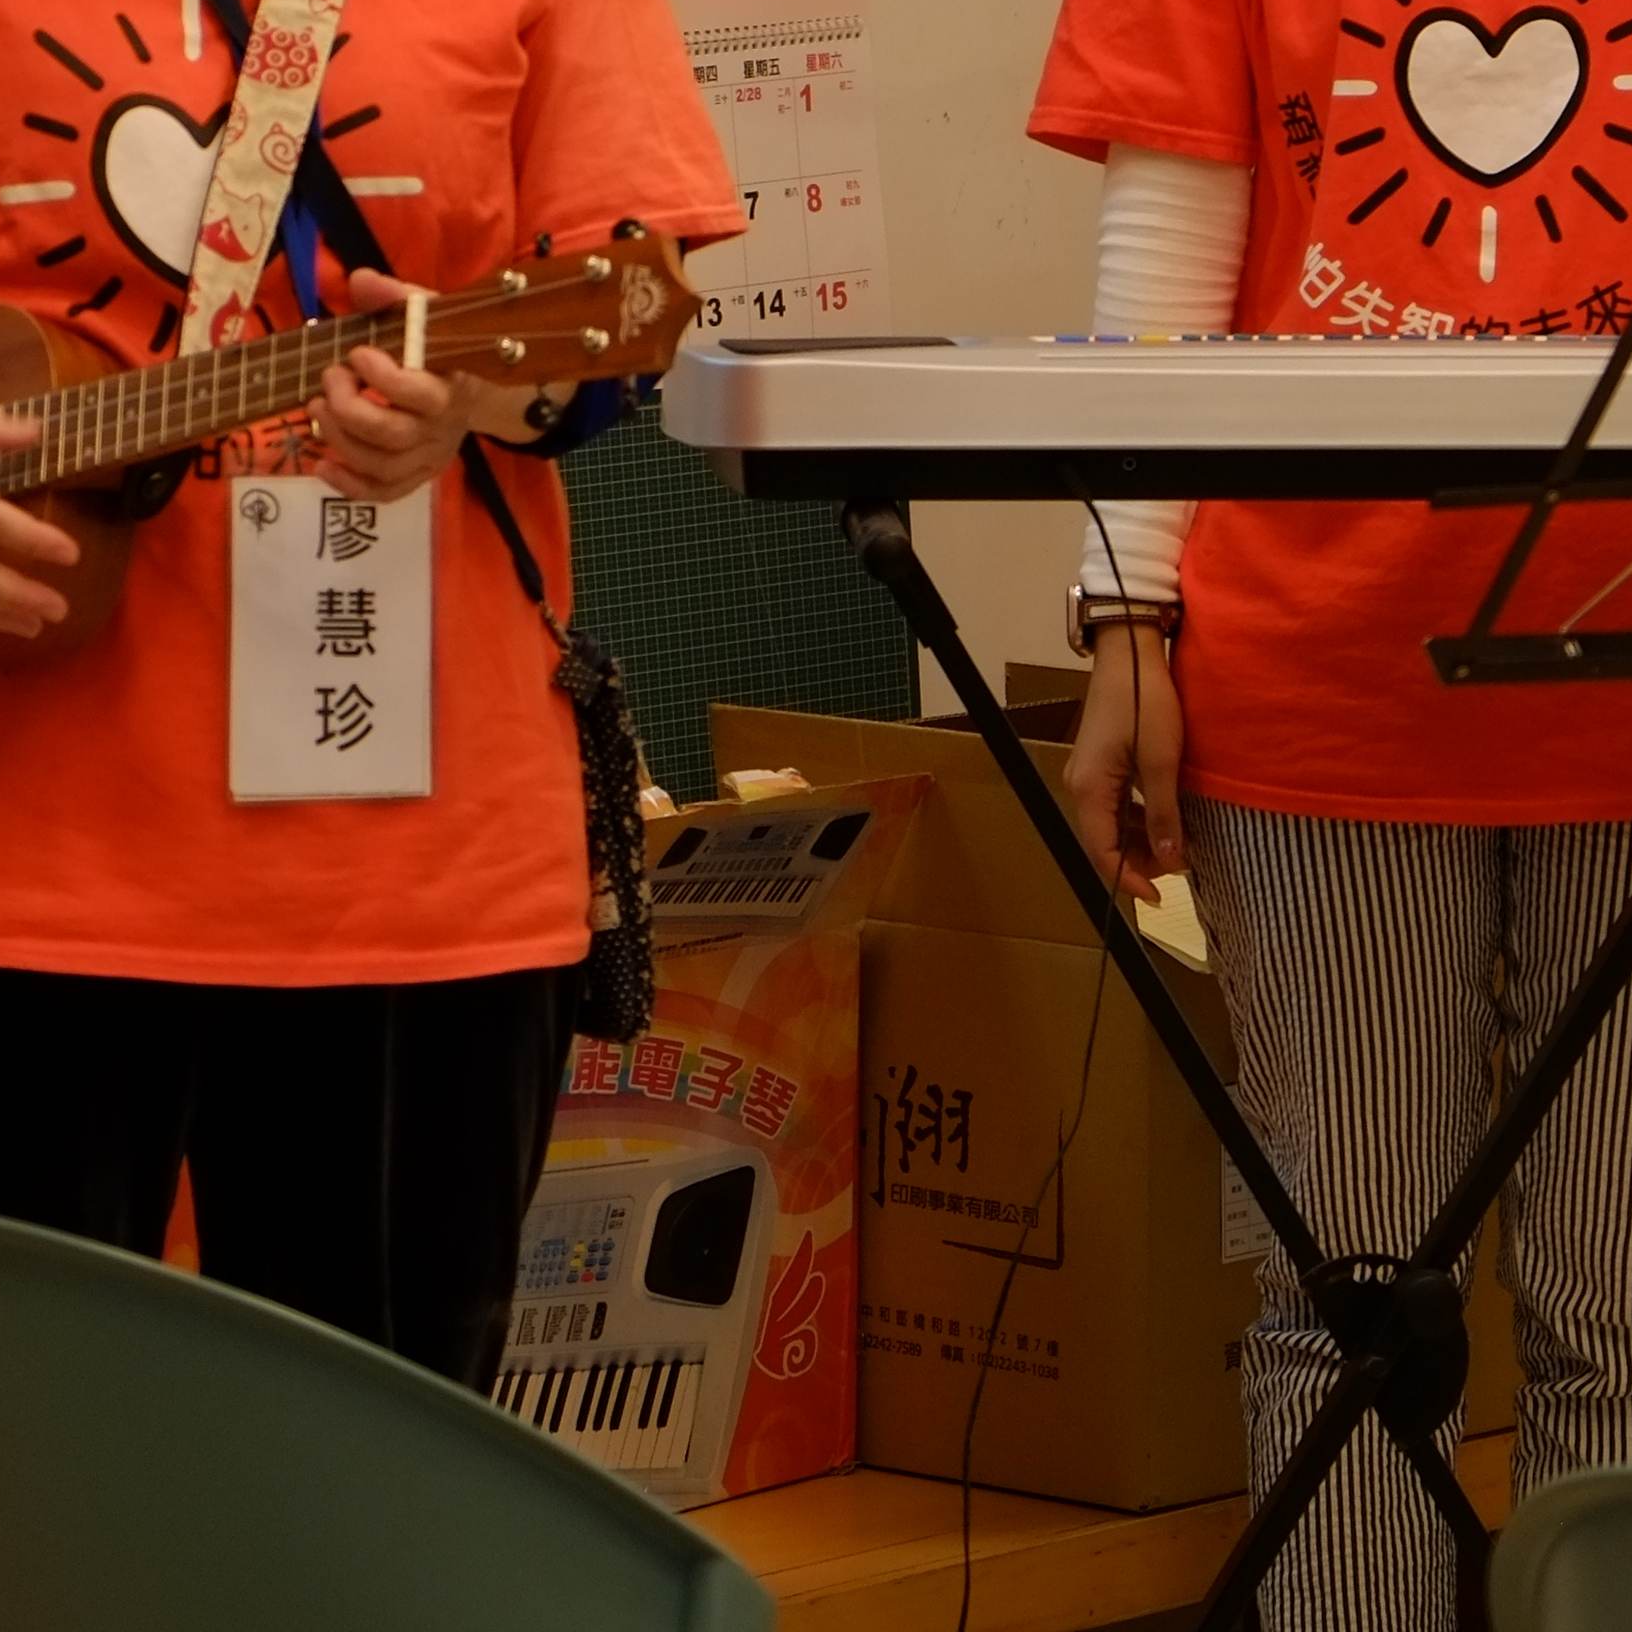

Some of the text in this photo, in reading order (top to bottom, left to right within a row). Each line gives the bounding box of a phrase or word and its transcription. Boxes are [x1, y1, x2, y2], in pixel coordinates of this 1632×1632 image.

[743, 58, 781, 80] 星期五
[806, 52, 844, 73] 星期六
[735, 86, 763, 103] 2/28
[799, 84, 813, 112] 1
[743, 191, 759, 220] 7
[806, 183, 823, 214] 8
[753, 289, 786, 322] 14
[816, 281, 848, 312] 15
[695, 298, 724, 329] 13
[315, 496, 379, 752] 廖慧珍
[571, 1033, 799, 1139] 能電子琴
[890, 1183, 1040, 1228] 印刷事業有限公司
